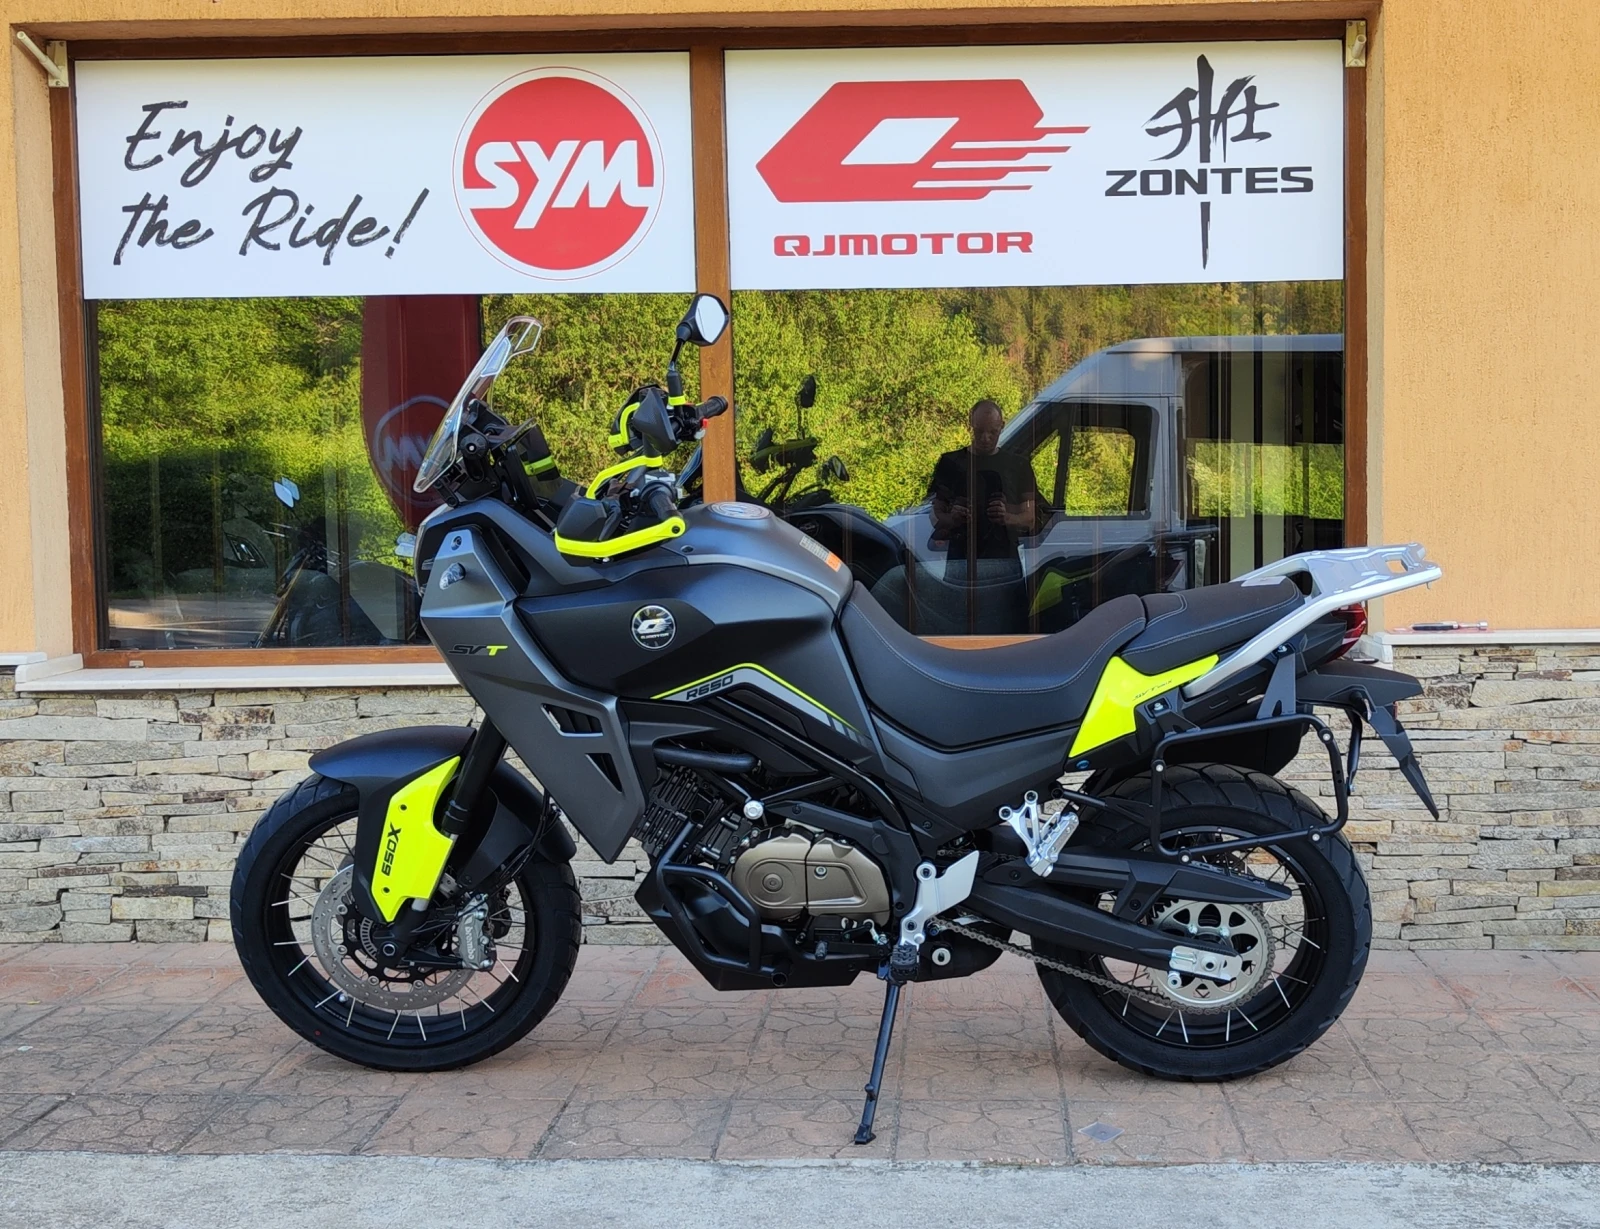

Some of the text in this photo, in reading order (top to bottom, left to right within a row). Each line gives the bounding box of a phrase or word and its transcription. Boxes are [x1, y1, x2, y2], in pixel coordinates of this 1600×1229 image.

[124, 100, 303, 188] Enjoy
[464, 139, 653, 229] SYM
[1105, 166, 1314, 196] ZONTES
[113, 187, 430, 266] the Ride!
[774, 231, 1033, 257] QJMOTOR
[449, 644, 508, 656] SVT
[686, 674, 733, 701] R650
[381, 822, 402, 876] 650X
